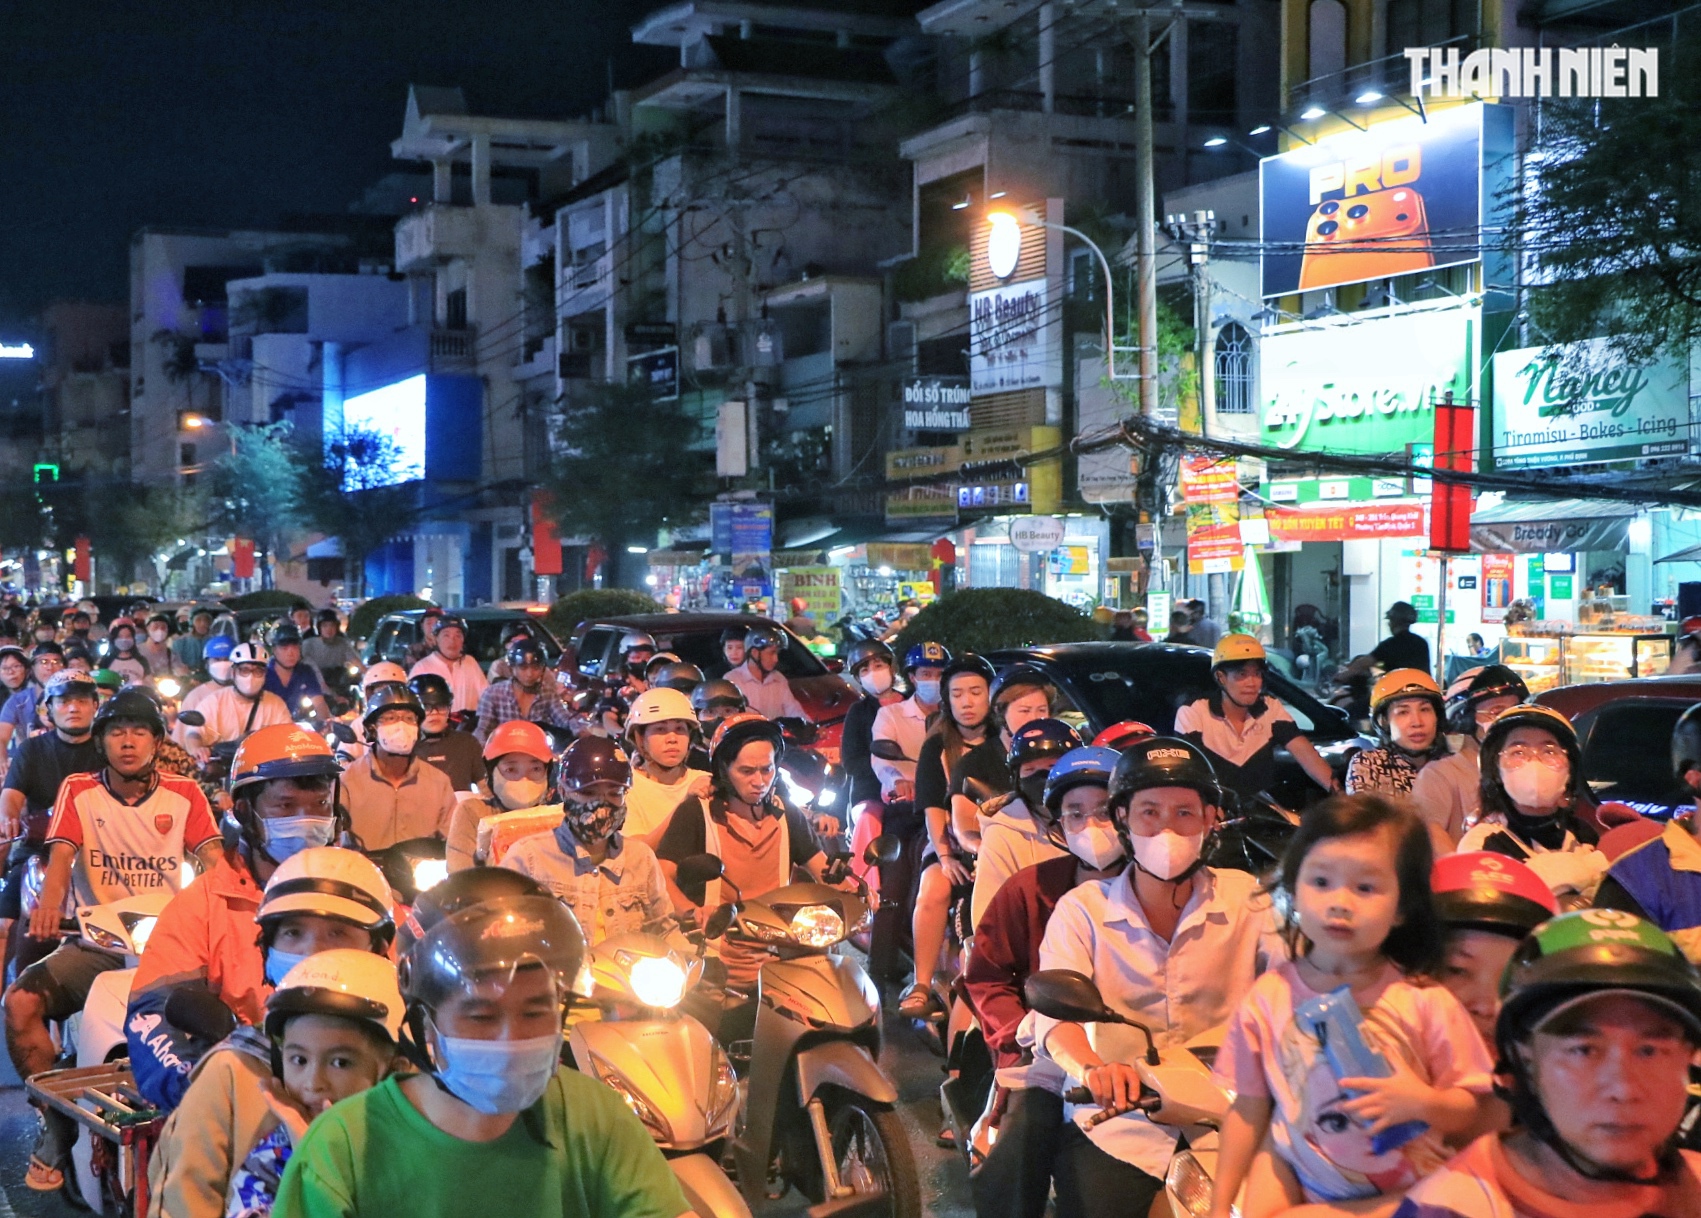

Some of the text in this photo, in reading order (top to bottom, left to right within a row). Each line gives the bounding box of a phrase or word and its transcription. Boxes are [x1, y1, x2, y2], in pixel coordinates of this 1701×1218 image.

[1309, 141, 1422, 206] PRO
[924, 380, 941, 403] SỐ
[1520, 358, 1648, 418] Nancy
[905, 410, 925, 427] HOA
[950, 406, 971, 428] THẤ
[1567, 401, 1594, 413] OOD
[1503, 427, 1567, 447] Tiramisu
[1580, 421, 1624, 440] Bakes
[1637, 416, 1676, 437] Icing
[1328, 515, 1344, 530] TẾT
[1514, 522, 1561, 541] Bready
[1015, 531, 1060, 541] HB Beauty
[1071, 759, 1101, 767] HONDA
[89, 850, 177, 871] Emirates
[101, 872, 164, 888] FLY BETTER
